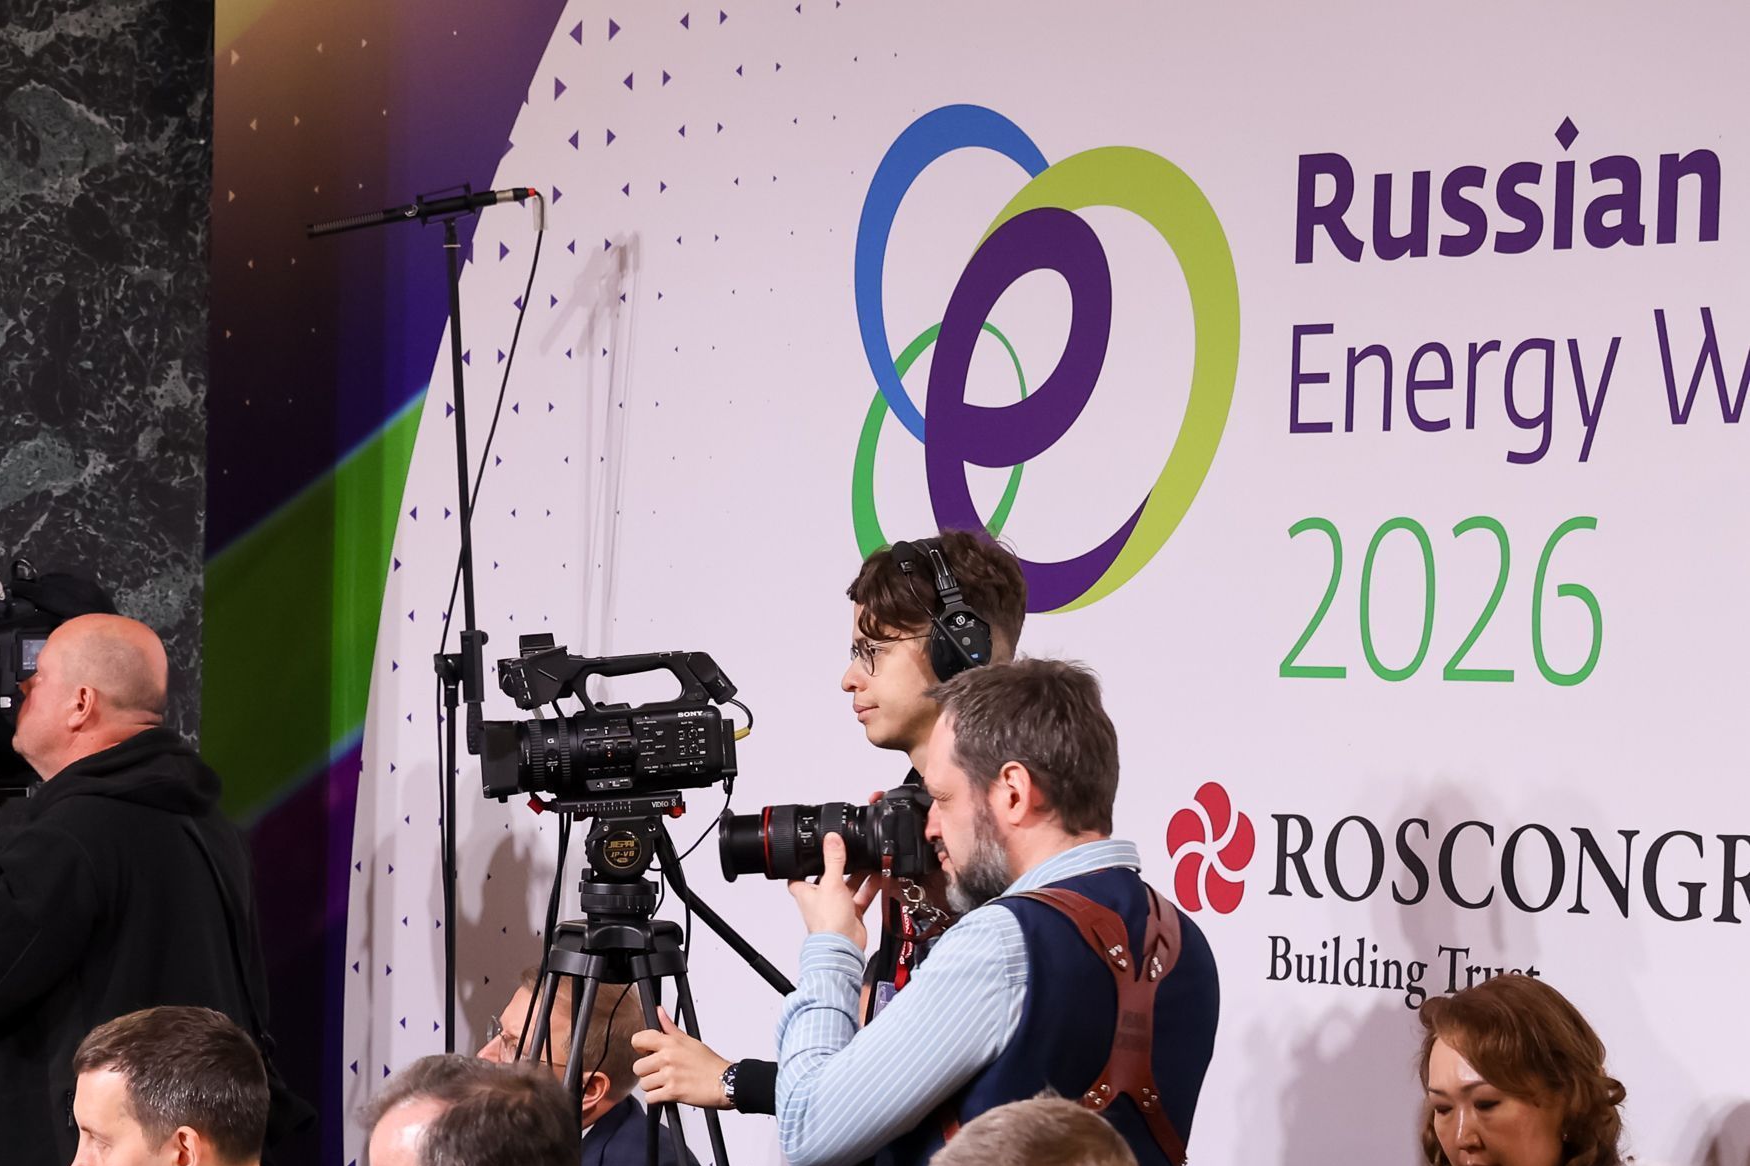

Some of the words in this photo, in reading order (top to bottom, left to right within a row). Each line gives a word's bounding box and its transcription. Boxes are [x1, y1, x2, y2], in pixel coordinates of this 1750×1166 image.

[1295, 115, 1722, 264] Russian
[1289, 322, 1622, 465] Energy
[1279, 515, 1603, 687] 2026
[677, 710, 704, 718] SONY
[1266, 934, 1427, 1010] Building
